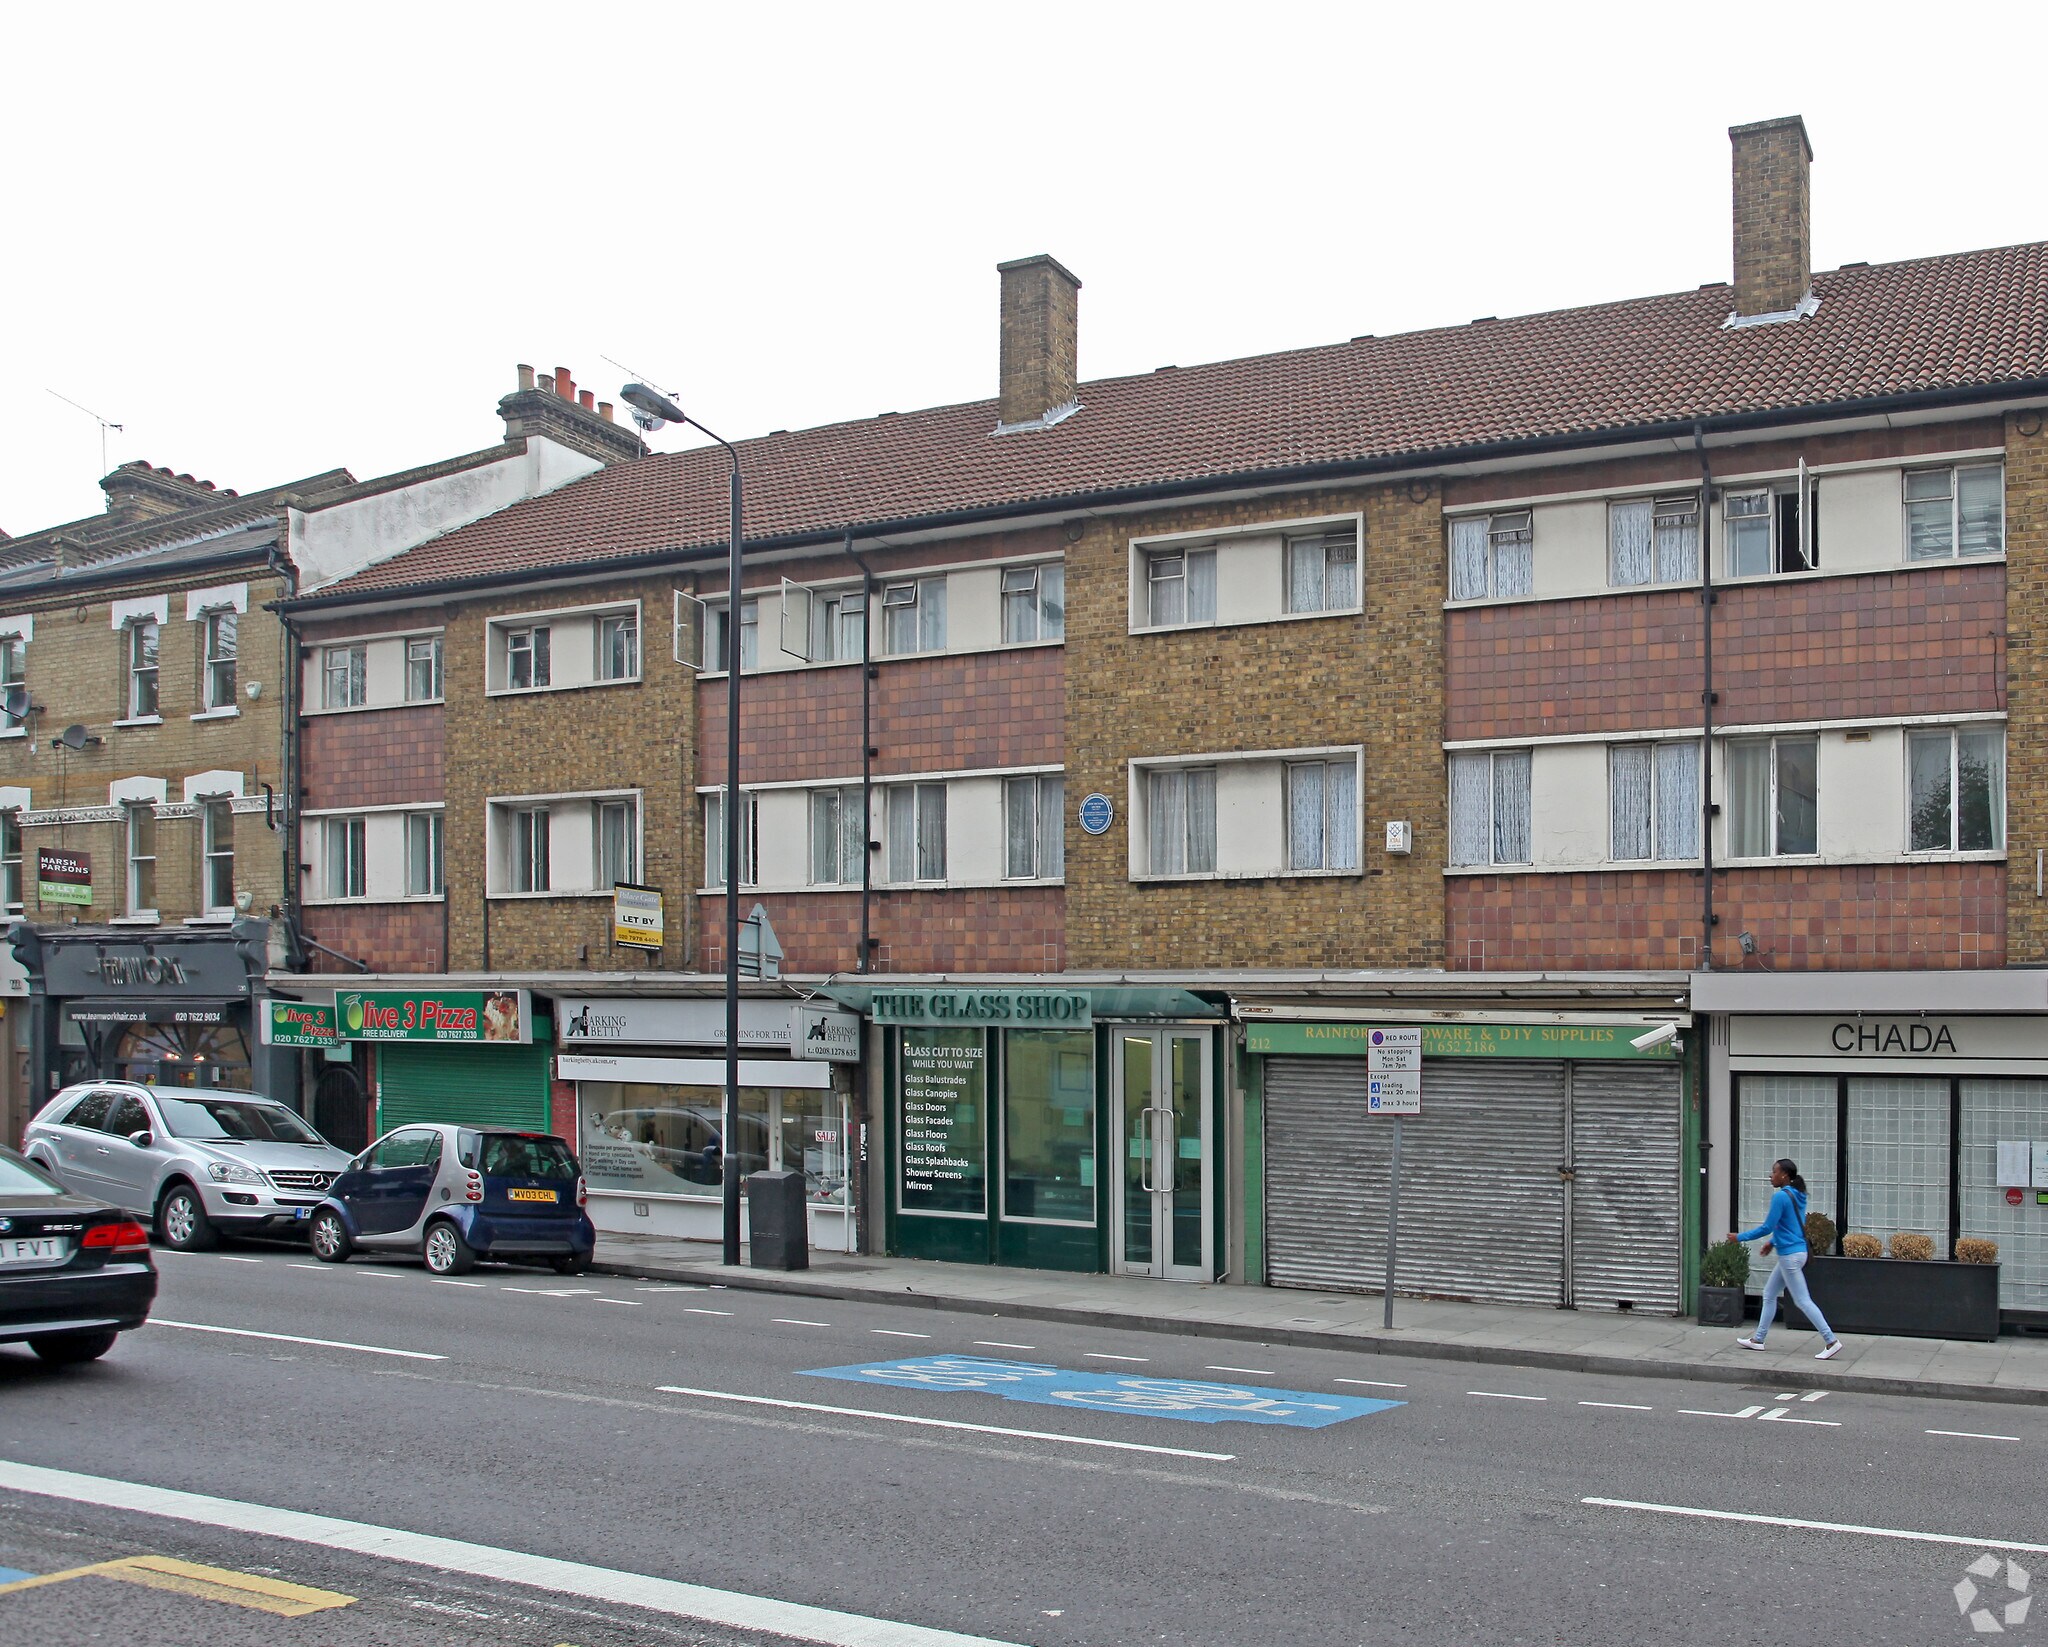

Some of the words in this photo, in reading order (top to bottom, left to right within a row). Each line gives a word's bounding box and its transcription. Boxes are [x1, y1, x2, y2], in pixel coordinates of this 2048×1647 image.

[41, 857, 76, 866] MARSH
[41, 863, 89, 874] PARSONS
[623, 915, 639, 923] LET
[873, 994, 924, 1018] THE
[928, 995, 1011, 1019] GLASS
[1016, 996, 1088, 1020] SHOP
[71, 1012, 147, 1022] www.teamworkhair.co.uk
[175, 1012, 187, 1021] 020
[189, 1012, 203, 1021] 7622
[204, 1013, 220, 1022] 9034
[316, 1011, 326, 1023] 3
[403, 1001, 416, 1029] 3
[420, 1000, 477, 1029] Pizza
[582, 1016, 627, 1026] BARKING
[301, 1023, 336, 1037] Pizza
[363, 1030, 378, 1038] FREE
[379, 1030, 408, 1038] DELIVERY
[463, 1031, 477, 1039] 3330
[591, 1026, 622, 1037] BETTY
[756, 1030, 770, 1039] FOR
[772, 1031, 787, 1039] THE
[821, 1025, 856, 1035] BARKING
[274, 1034, 291, 1043] 020
[294, 1035, 315, 1044] 7627
[317, 1036, 338, 1045] 3330
[827, 1033, 852, 1042] BETTY
[1481, 1029, 1492, 1040] &
[1500, 1029, 1533, 1040] DIY
[1542, 1029, 1614, 1042] SUPPLIES
[1832, 1023, 1957, 1053] CHADA
[1250, 1038, 1271, 1049] 212
[1437, 1041, 1461, 1052] 652
[1465, 1042, 1496, 1053] 2186
[816, 1047, 830, 1055] 0208
[831, 1047, 845, 1056] 1278
[904, 1047, 930, 1057] GLASS
[932, 1047, 949, 1057] CUT
[951, 1048, 963, 1057] TO
[965, 1048, 983, 1058] SIZE
[1648, 1043, 1671, 1055] 212
[912, 1060, 935, 1068] WHILE
[937, 1060, 953, 1068] YOU
[954, 1060, 973, 1069] WAIT
[905, 1075, 924, 1083] Glass
[925, 1075, 966, 1084] Balustrades
[905, 1088, 924, 1097] Glass
[925, 1089, 958, 1099] Canopies
[905, 1102, 924, 1110] Glass
[925, 1102, 946, 1112] Doors
[905, 1116, 924, 1124] Glass
[925, 1116, 953, 1126] Facades
[817, 1131, 836, 1141] SALE
[905, 1129, 924, 1138] Glass
[925, 1129, 947, 1139] Floors
[905, 1142, 924, 1151] Glass
[925, 1143, 945, 1152] Roofs
[905, 1156, 924, 1164] Glass
[925, 1156, 968, 1167] Splashbacks
[906, 1168, 933, 1177] Shower
[934, 1169, 962, 1179] Screens
[906, 1181, 933, 1190] Mirrors
[538, 1190, 554, 1200] CHL
[16, 1240, 53, 1257] FVT
